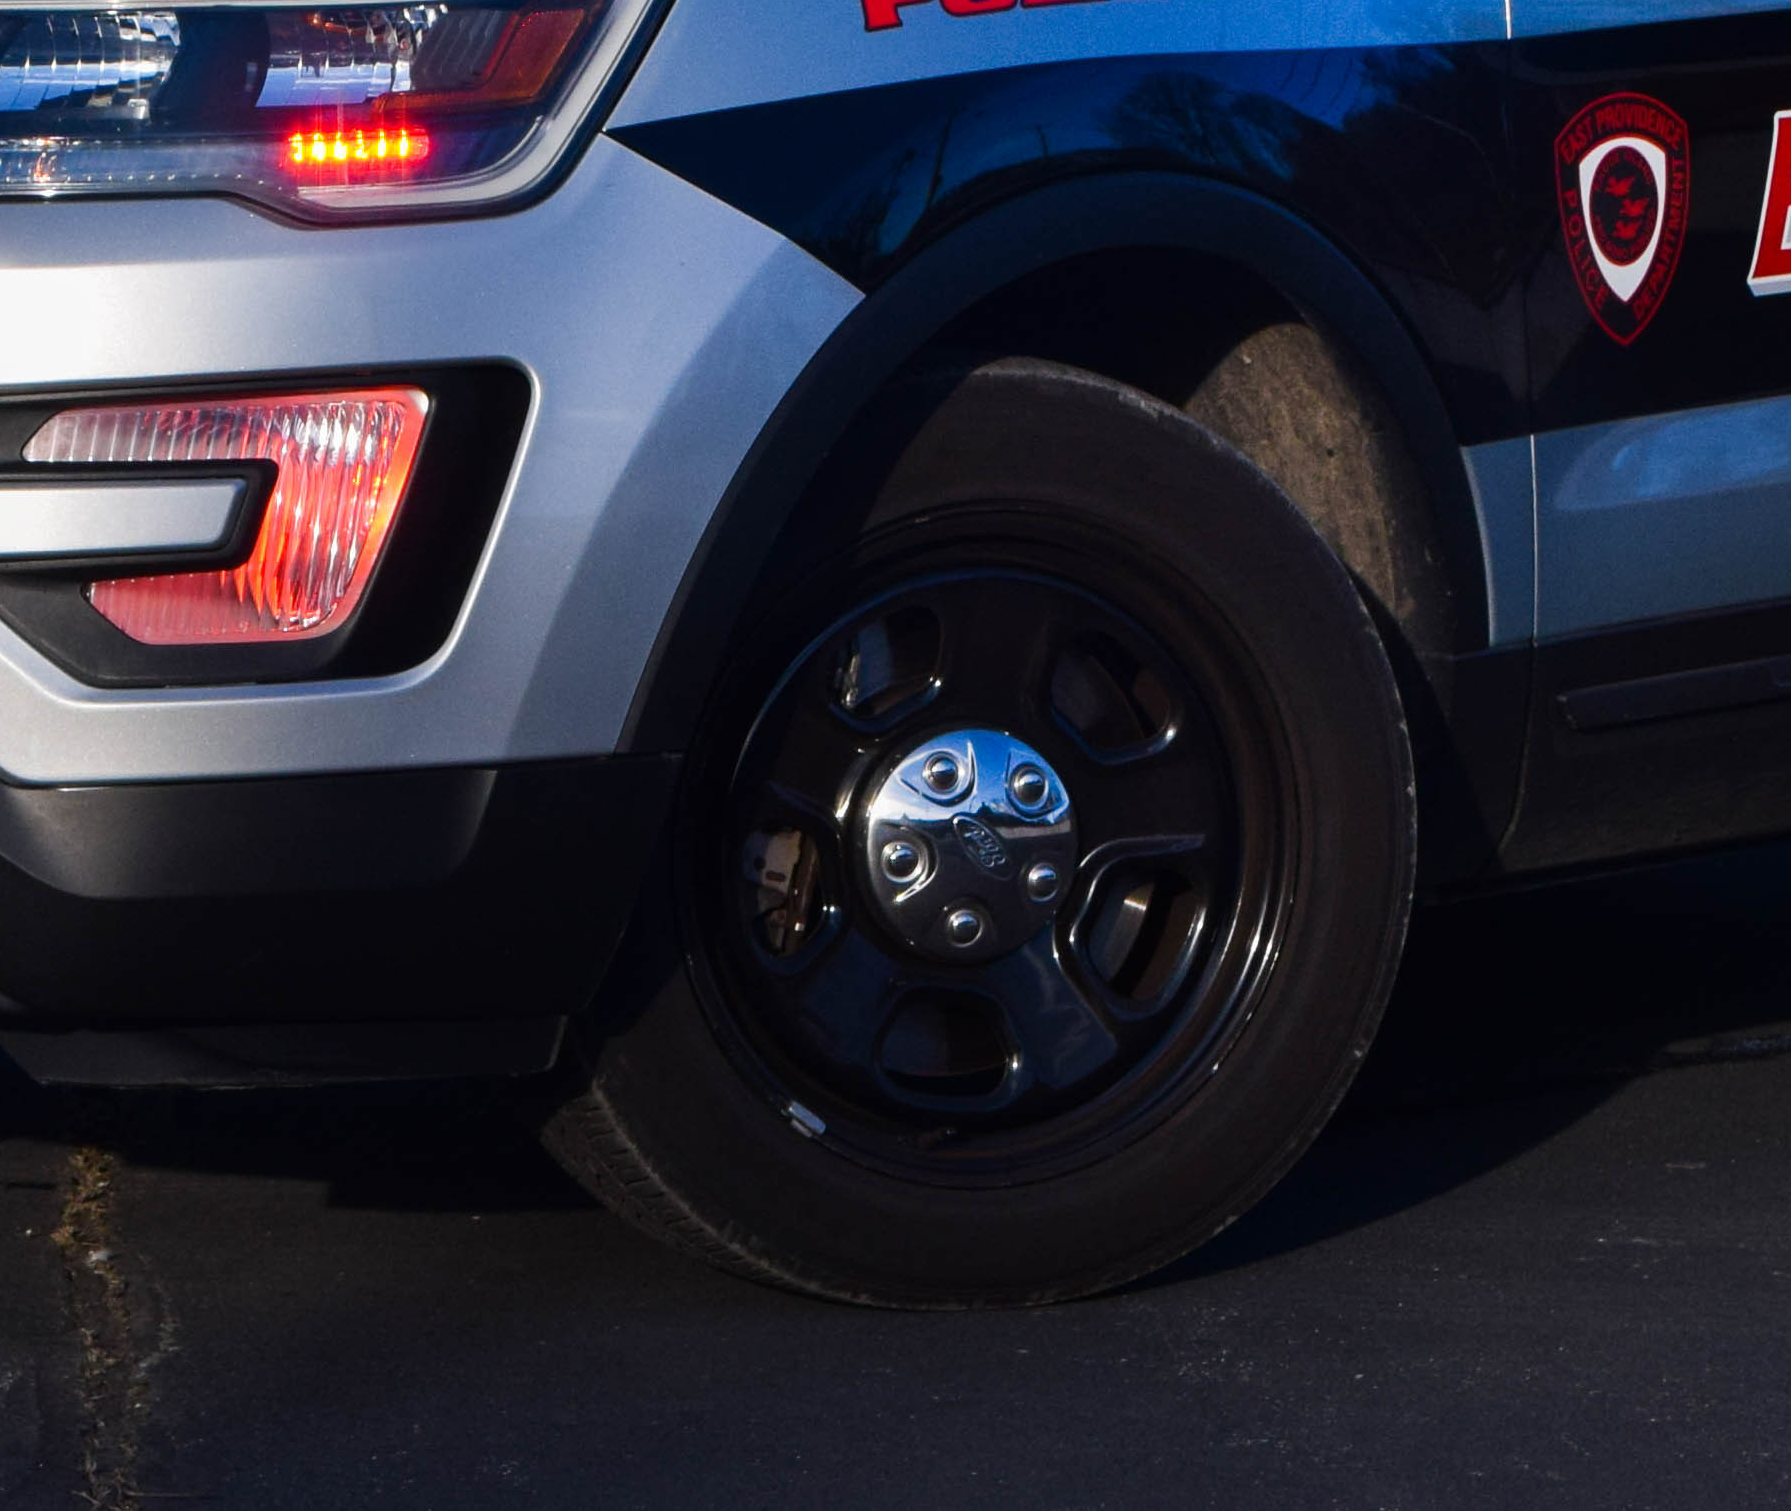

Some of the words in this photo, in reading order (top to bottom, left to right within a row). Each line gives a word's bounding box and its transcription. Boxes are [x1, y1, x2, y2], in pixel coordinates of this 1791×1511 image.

[1560, 116, 1594, 164] EAST
[1595, 103, 1684, 151] PROVIDENCE
[1562, 190, 1609, 311] POLICE
